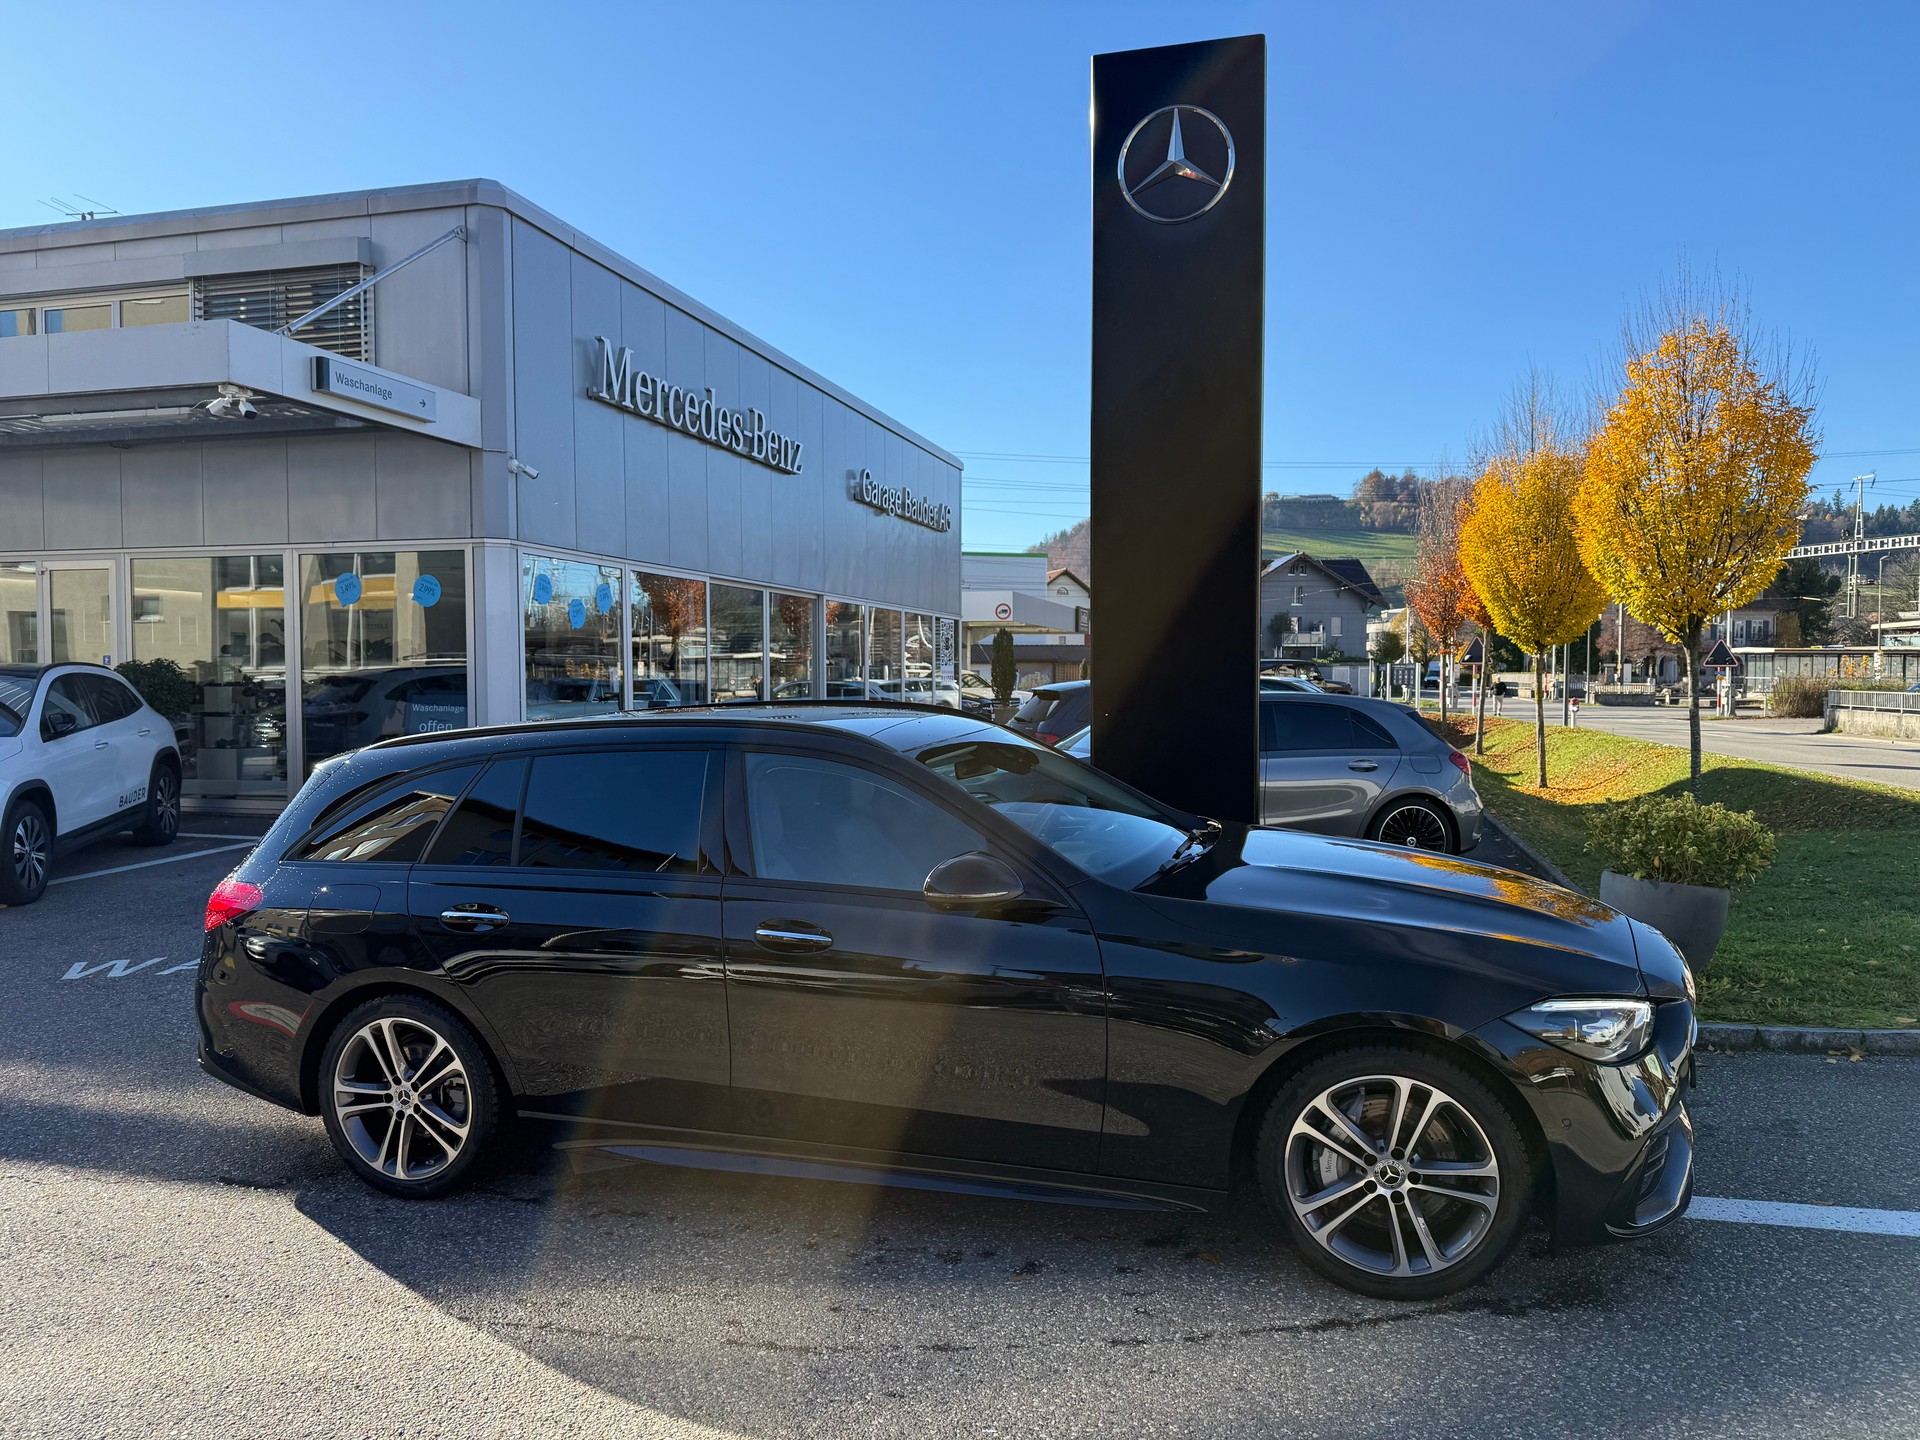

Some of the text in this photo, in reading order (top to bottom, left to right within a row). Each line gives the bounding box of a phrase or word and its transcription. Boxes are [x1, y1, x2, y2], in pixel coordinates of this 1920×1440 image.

[335, 371, 393, 401] Waschanlage
[597, 335, 804, 475] Mercedes-Benz
[862, 469, 952, 532] Garage Bauder AG
[412, 703, 465, 714] Waschanlage
[419, 720, 453, 733] offen
[118, 787, 146, 808] BAUDER
